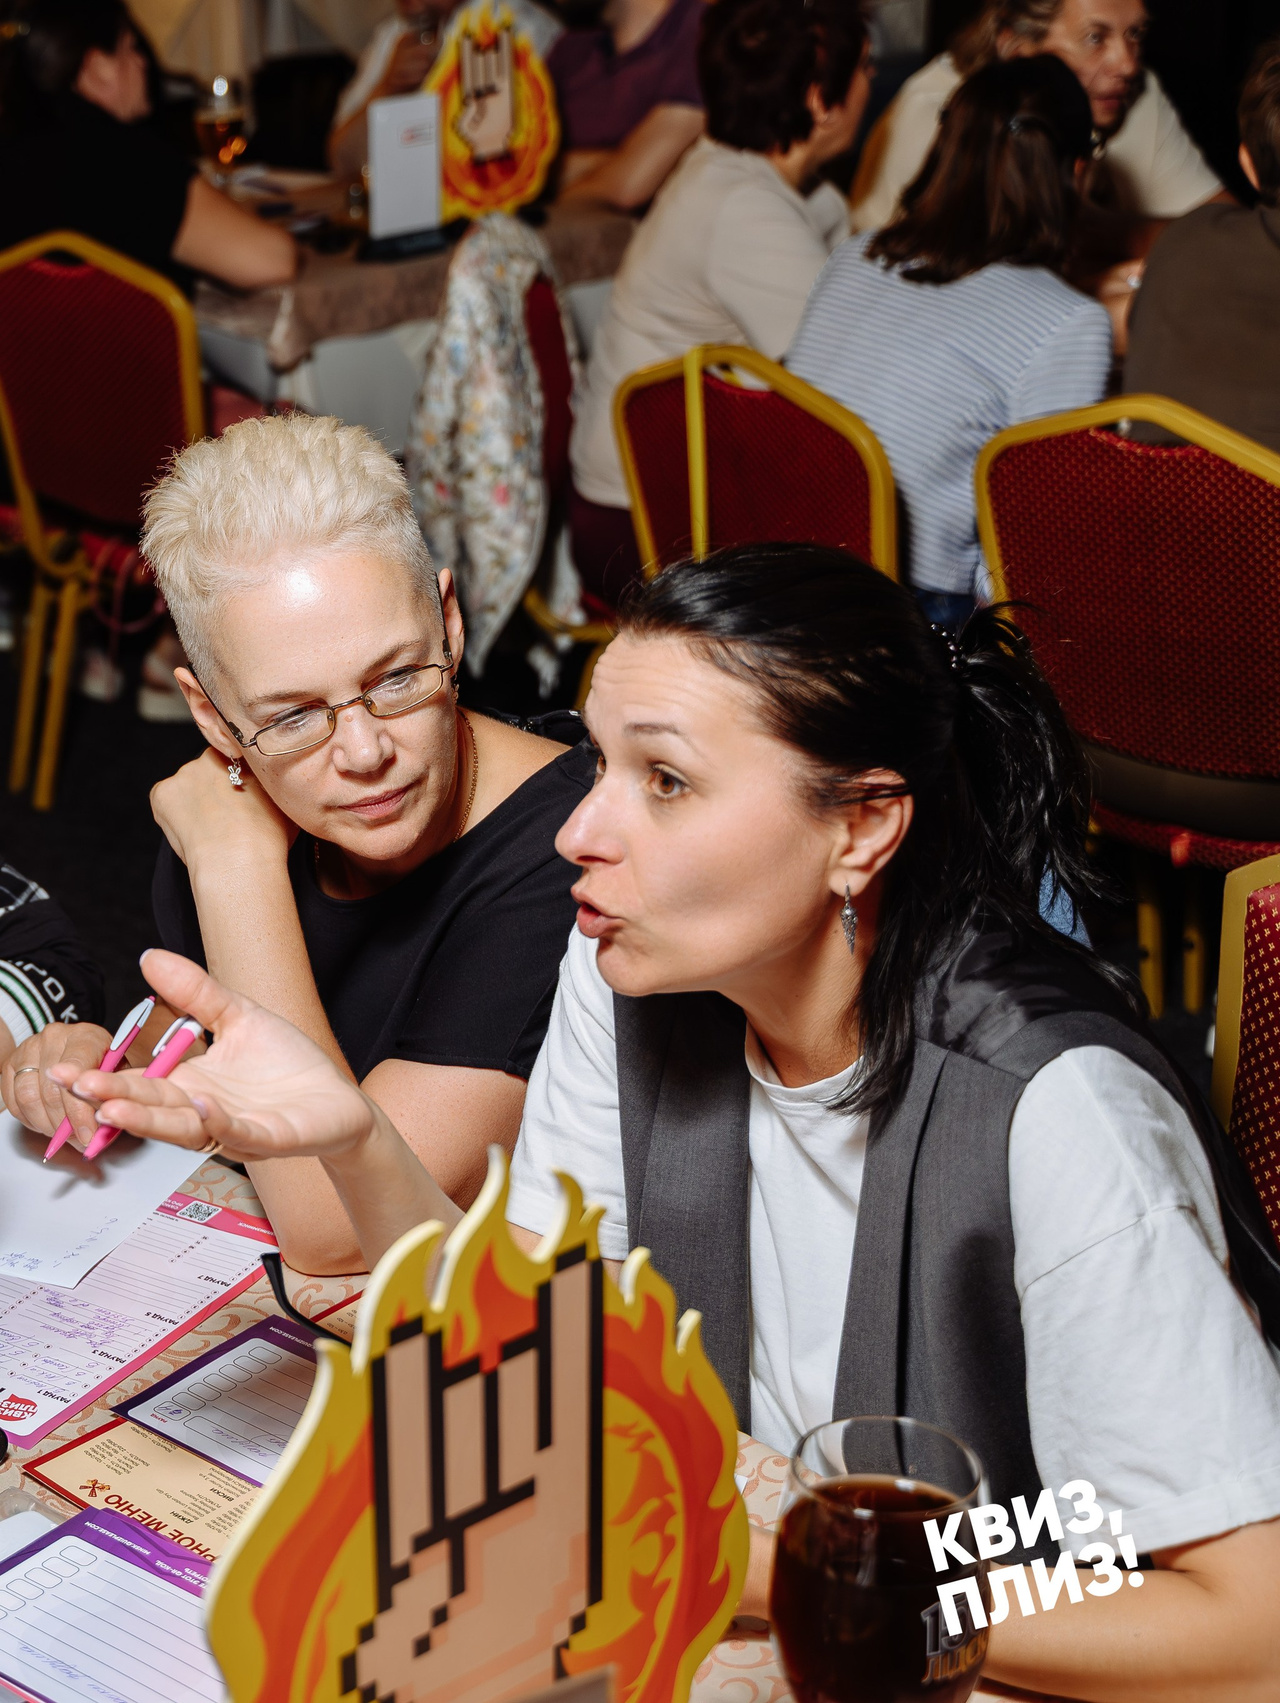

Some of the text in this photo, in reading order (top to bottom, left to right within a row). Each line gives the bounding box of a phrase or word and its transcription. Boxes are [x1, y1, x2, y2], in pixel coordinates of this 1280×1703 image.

[201, 1275, 231, 1288] РАУНД
[149, 1312, 180, 1326] РАУНД
[96, 1350, 128, 1363] РАУНД
[43, 1390, 72, 1404] РАУНД
[209, 1487, 235, 1502] ВИСКИ
[169, 1510, 194, 1525] ДЖИН
[103, 1494, 218, 1562] РНОЕ МЕНЮ
[82, 1520, 152, 1555] MINSK.QUIZPLEASE.COM
[179, 1573, 201, 1585] ЭТОТ
[181, 1567, 212, 1582] ОТРЕТЬ
